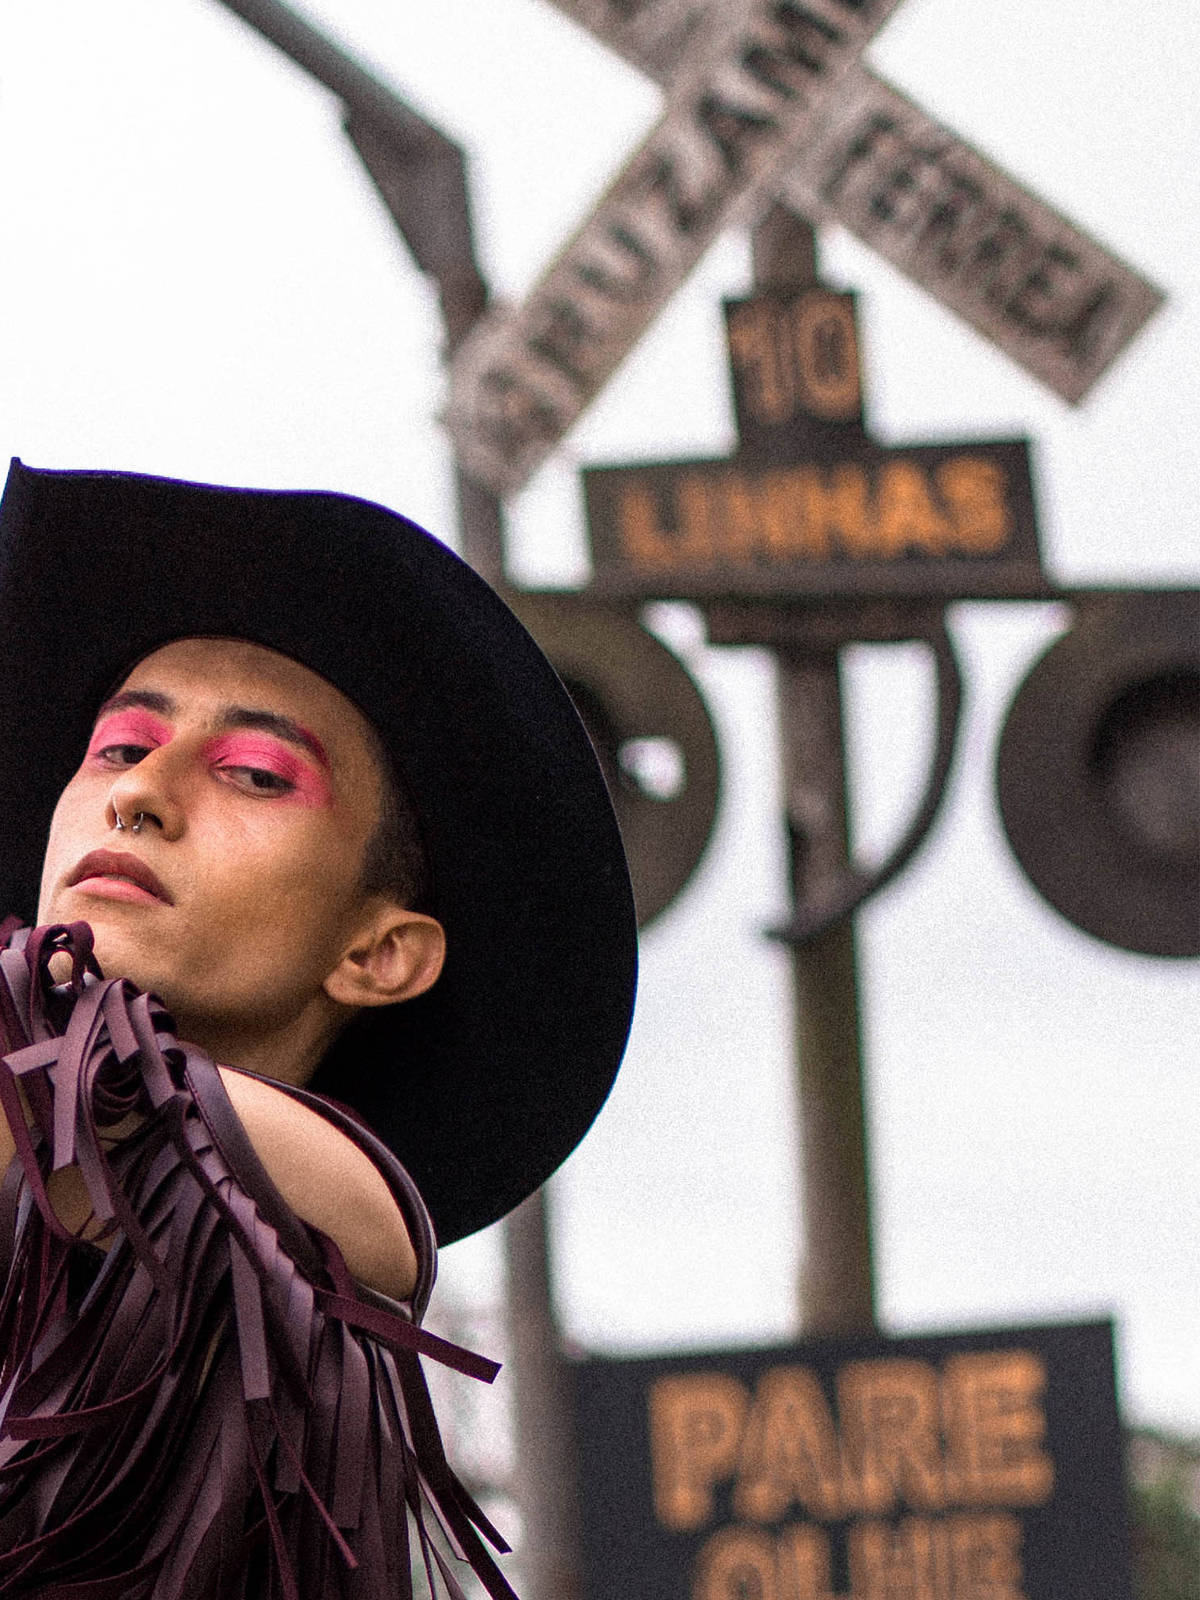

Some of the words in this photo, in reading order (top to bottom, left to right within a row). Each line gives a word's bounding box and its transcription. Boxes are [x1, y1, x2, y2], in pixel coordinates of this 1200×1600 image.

[730, 298, 863, 424] 10
[621, 456, 1011, 573] LINHAS
[651, 1350, 1053, 1529] PARE
